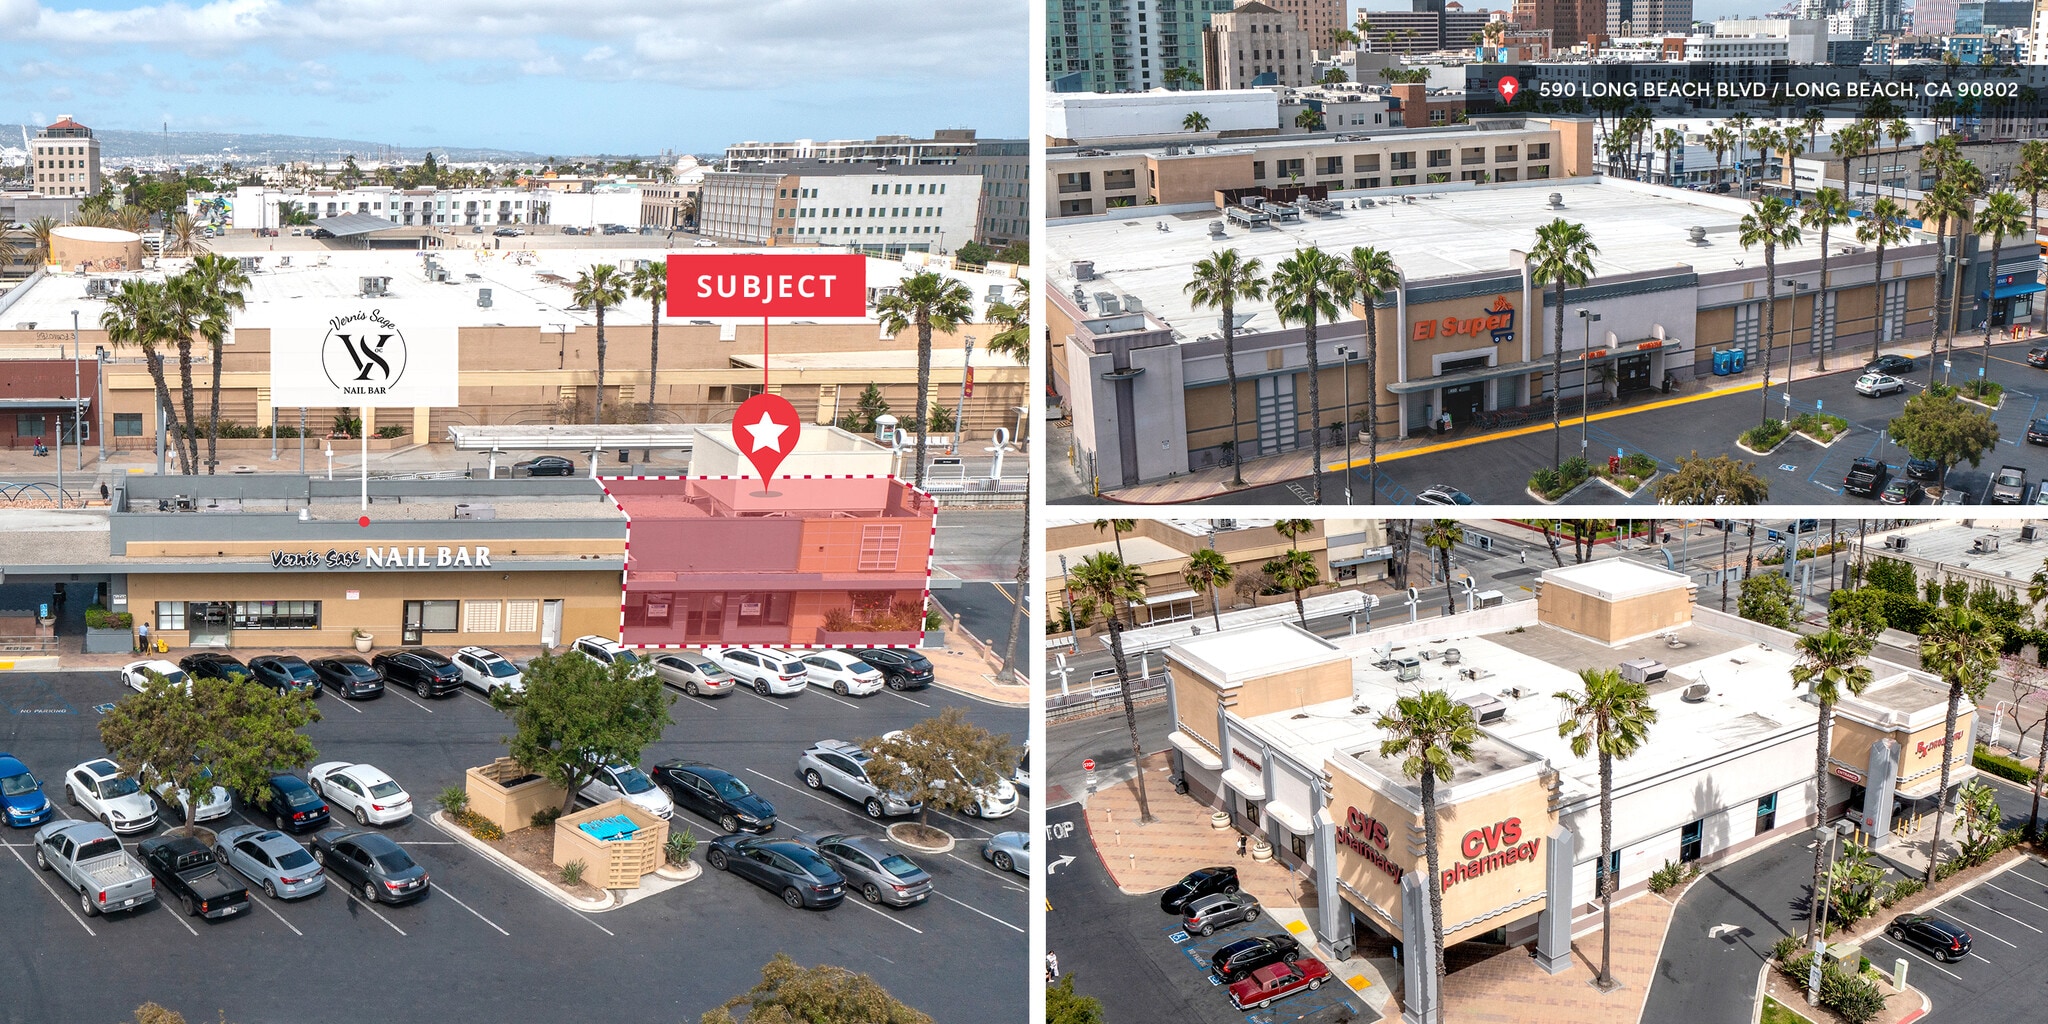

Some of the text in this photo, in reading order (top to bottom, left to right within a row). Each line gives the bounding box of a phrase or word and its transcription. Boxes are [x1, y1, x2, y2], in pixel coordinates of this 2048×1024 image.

[1413, 313, 1511, 341] El Super
[270, 545, 492, 568] Vernis Sage NAIL BAR
[1347, 806, 1389, 850] CVS
[1461, 817, 1522, 860] CVS
[1336, 826, 1404, 885] pharmacy
[1441, 837, 1541, 894] pharmacy
